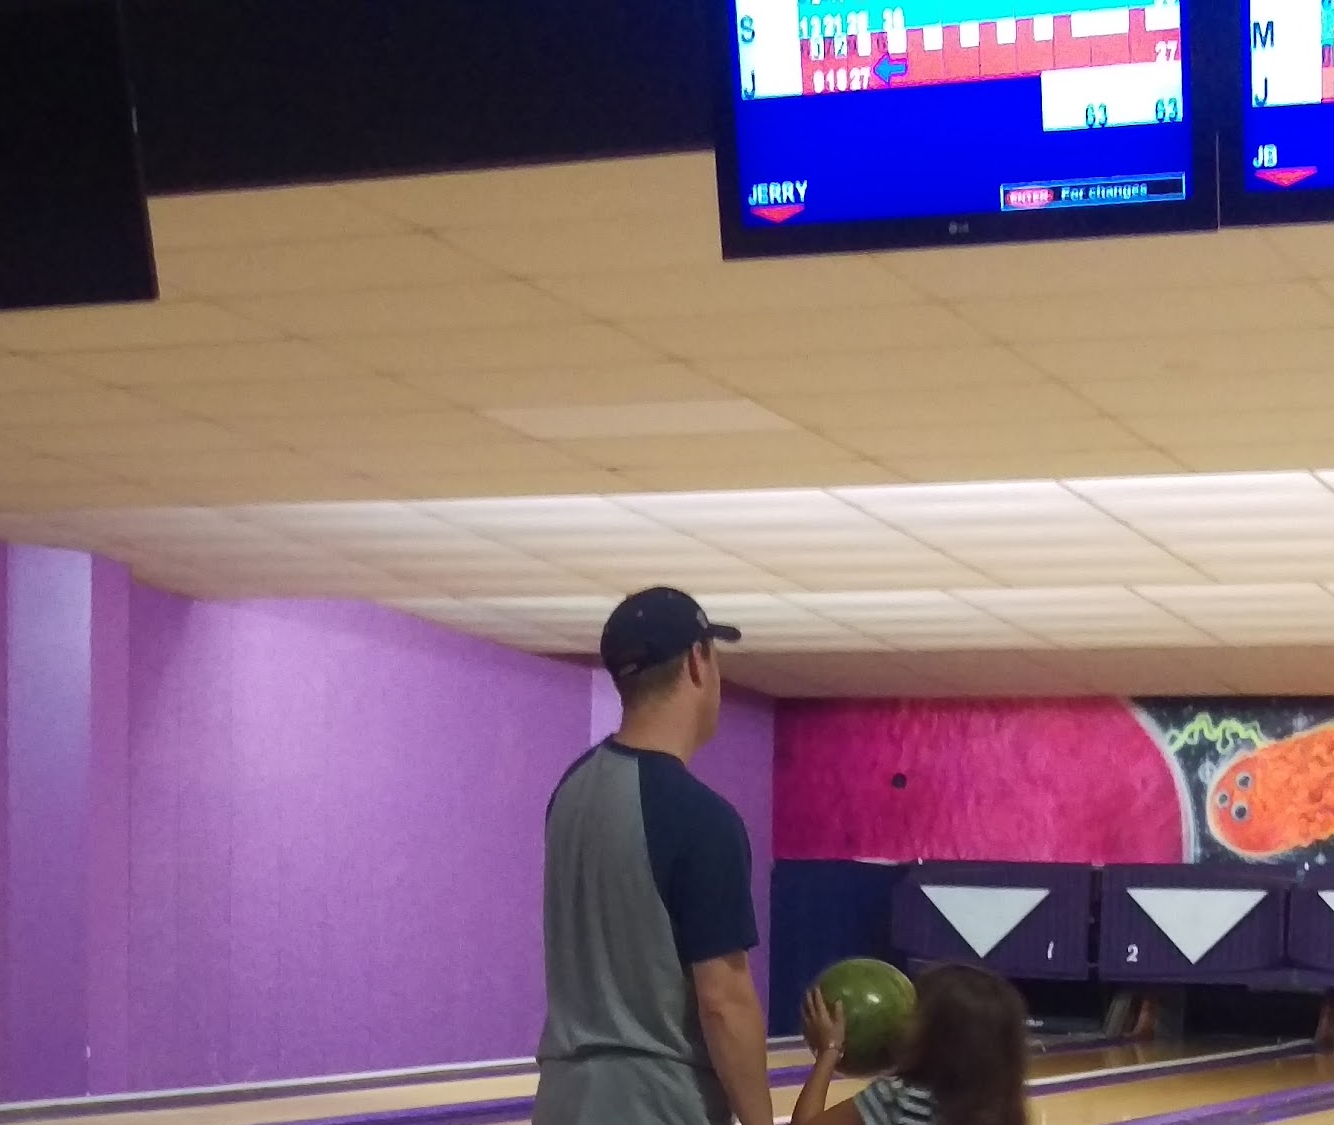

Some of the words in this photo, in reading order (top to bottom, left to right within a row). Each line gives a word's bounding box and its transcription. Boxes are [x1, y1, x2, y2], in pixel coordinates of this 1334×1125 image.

[740, 15, 755, 43] S
[1253, 21, 1274, 48] M
[743, 70, 755, 99] J
[1255, 77, 1267, 106] J
[1155, 98, 1177, 122] 63
[748, 180, 807, 206] JERRY
[1089, 183, 1147, 199] changes
[1126, 944, 1139, 964] 2
